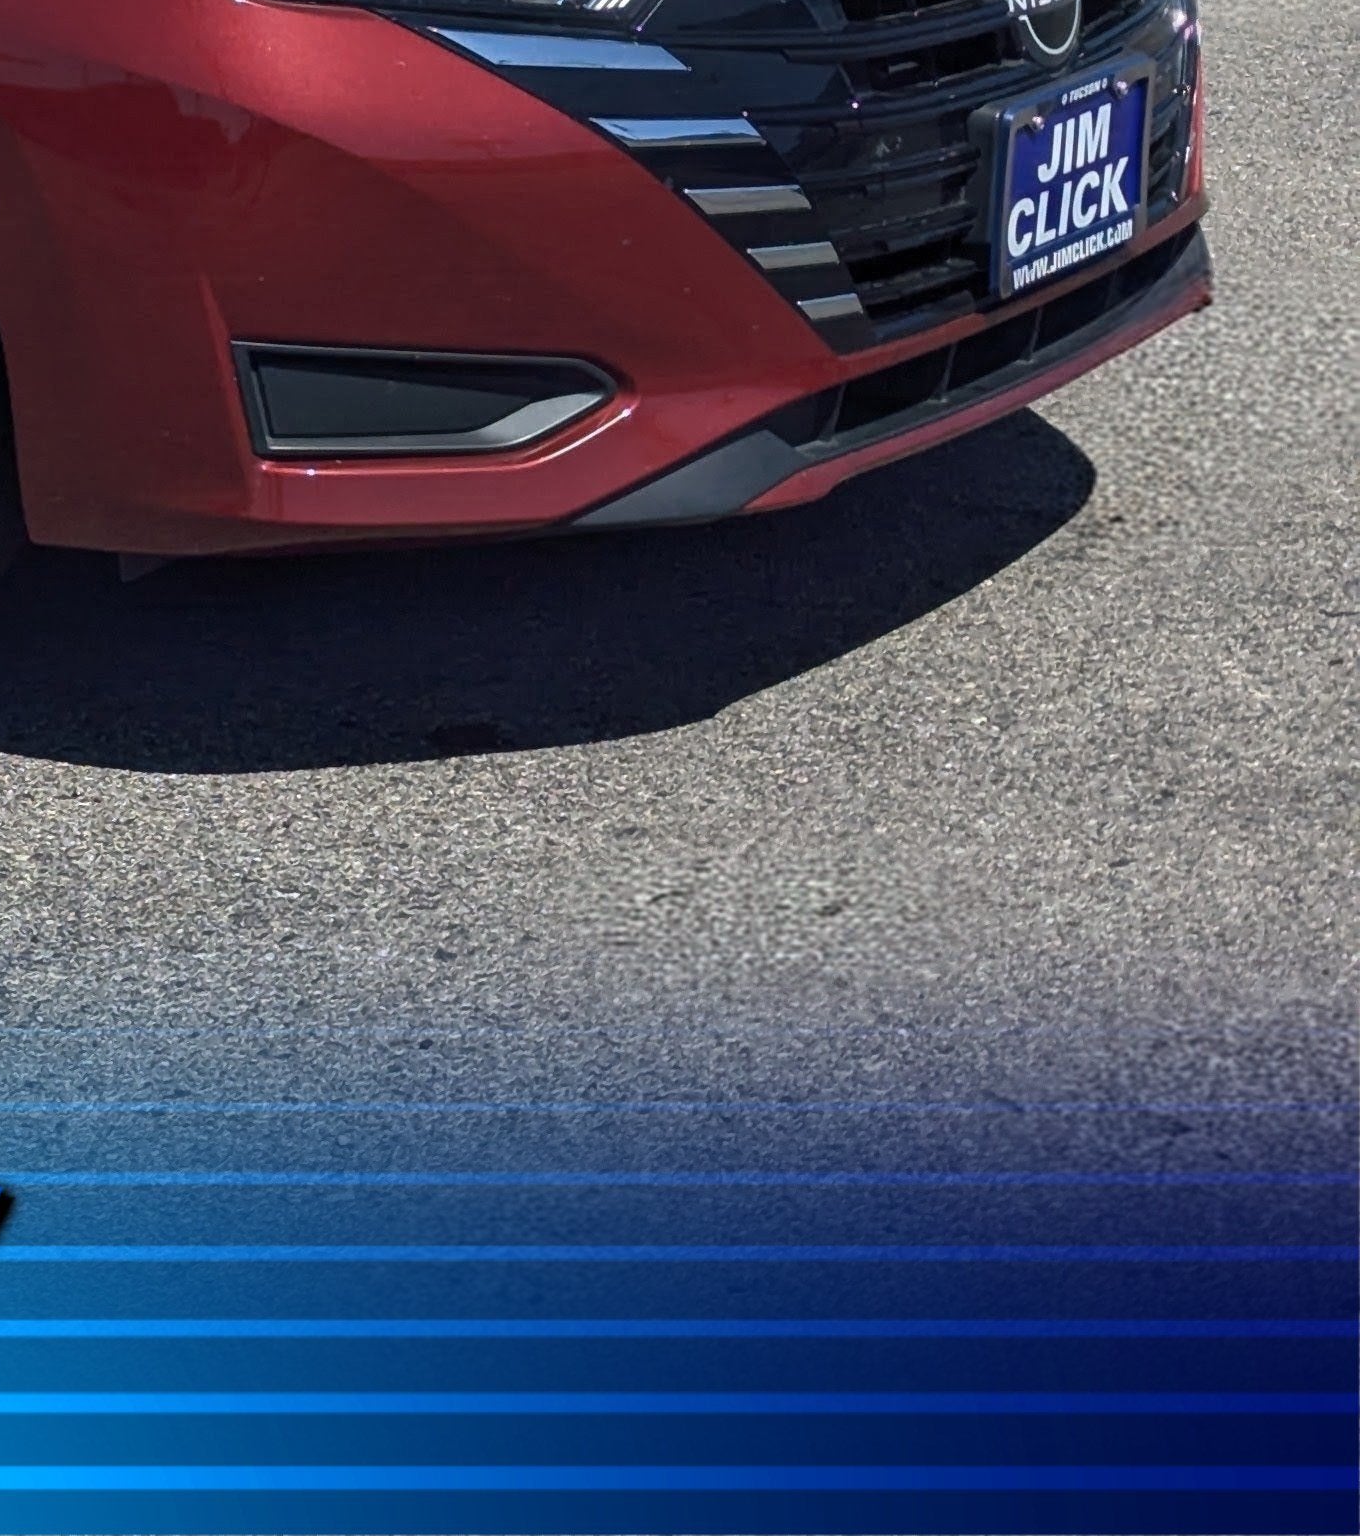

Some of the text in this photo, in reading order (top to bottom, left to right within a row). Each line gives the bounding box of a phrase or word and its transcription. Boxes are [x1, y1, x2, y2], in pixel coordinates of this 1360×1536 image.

[1038, 103, 1112, 183] JIM
[1007, 156, 1129, 258] CLICK
[1013, 219, 1133, 291] WWW.JIMCLICK.COM
